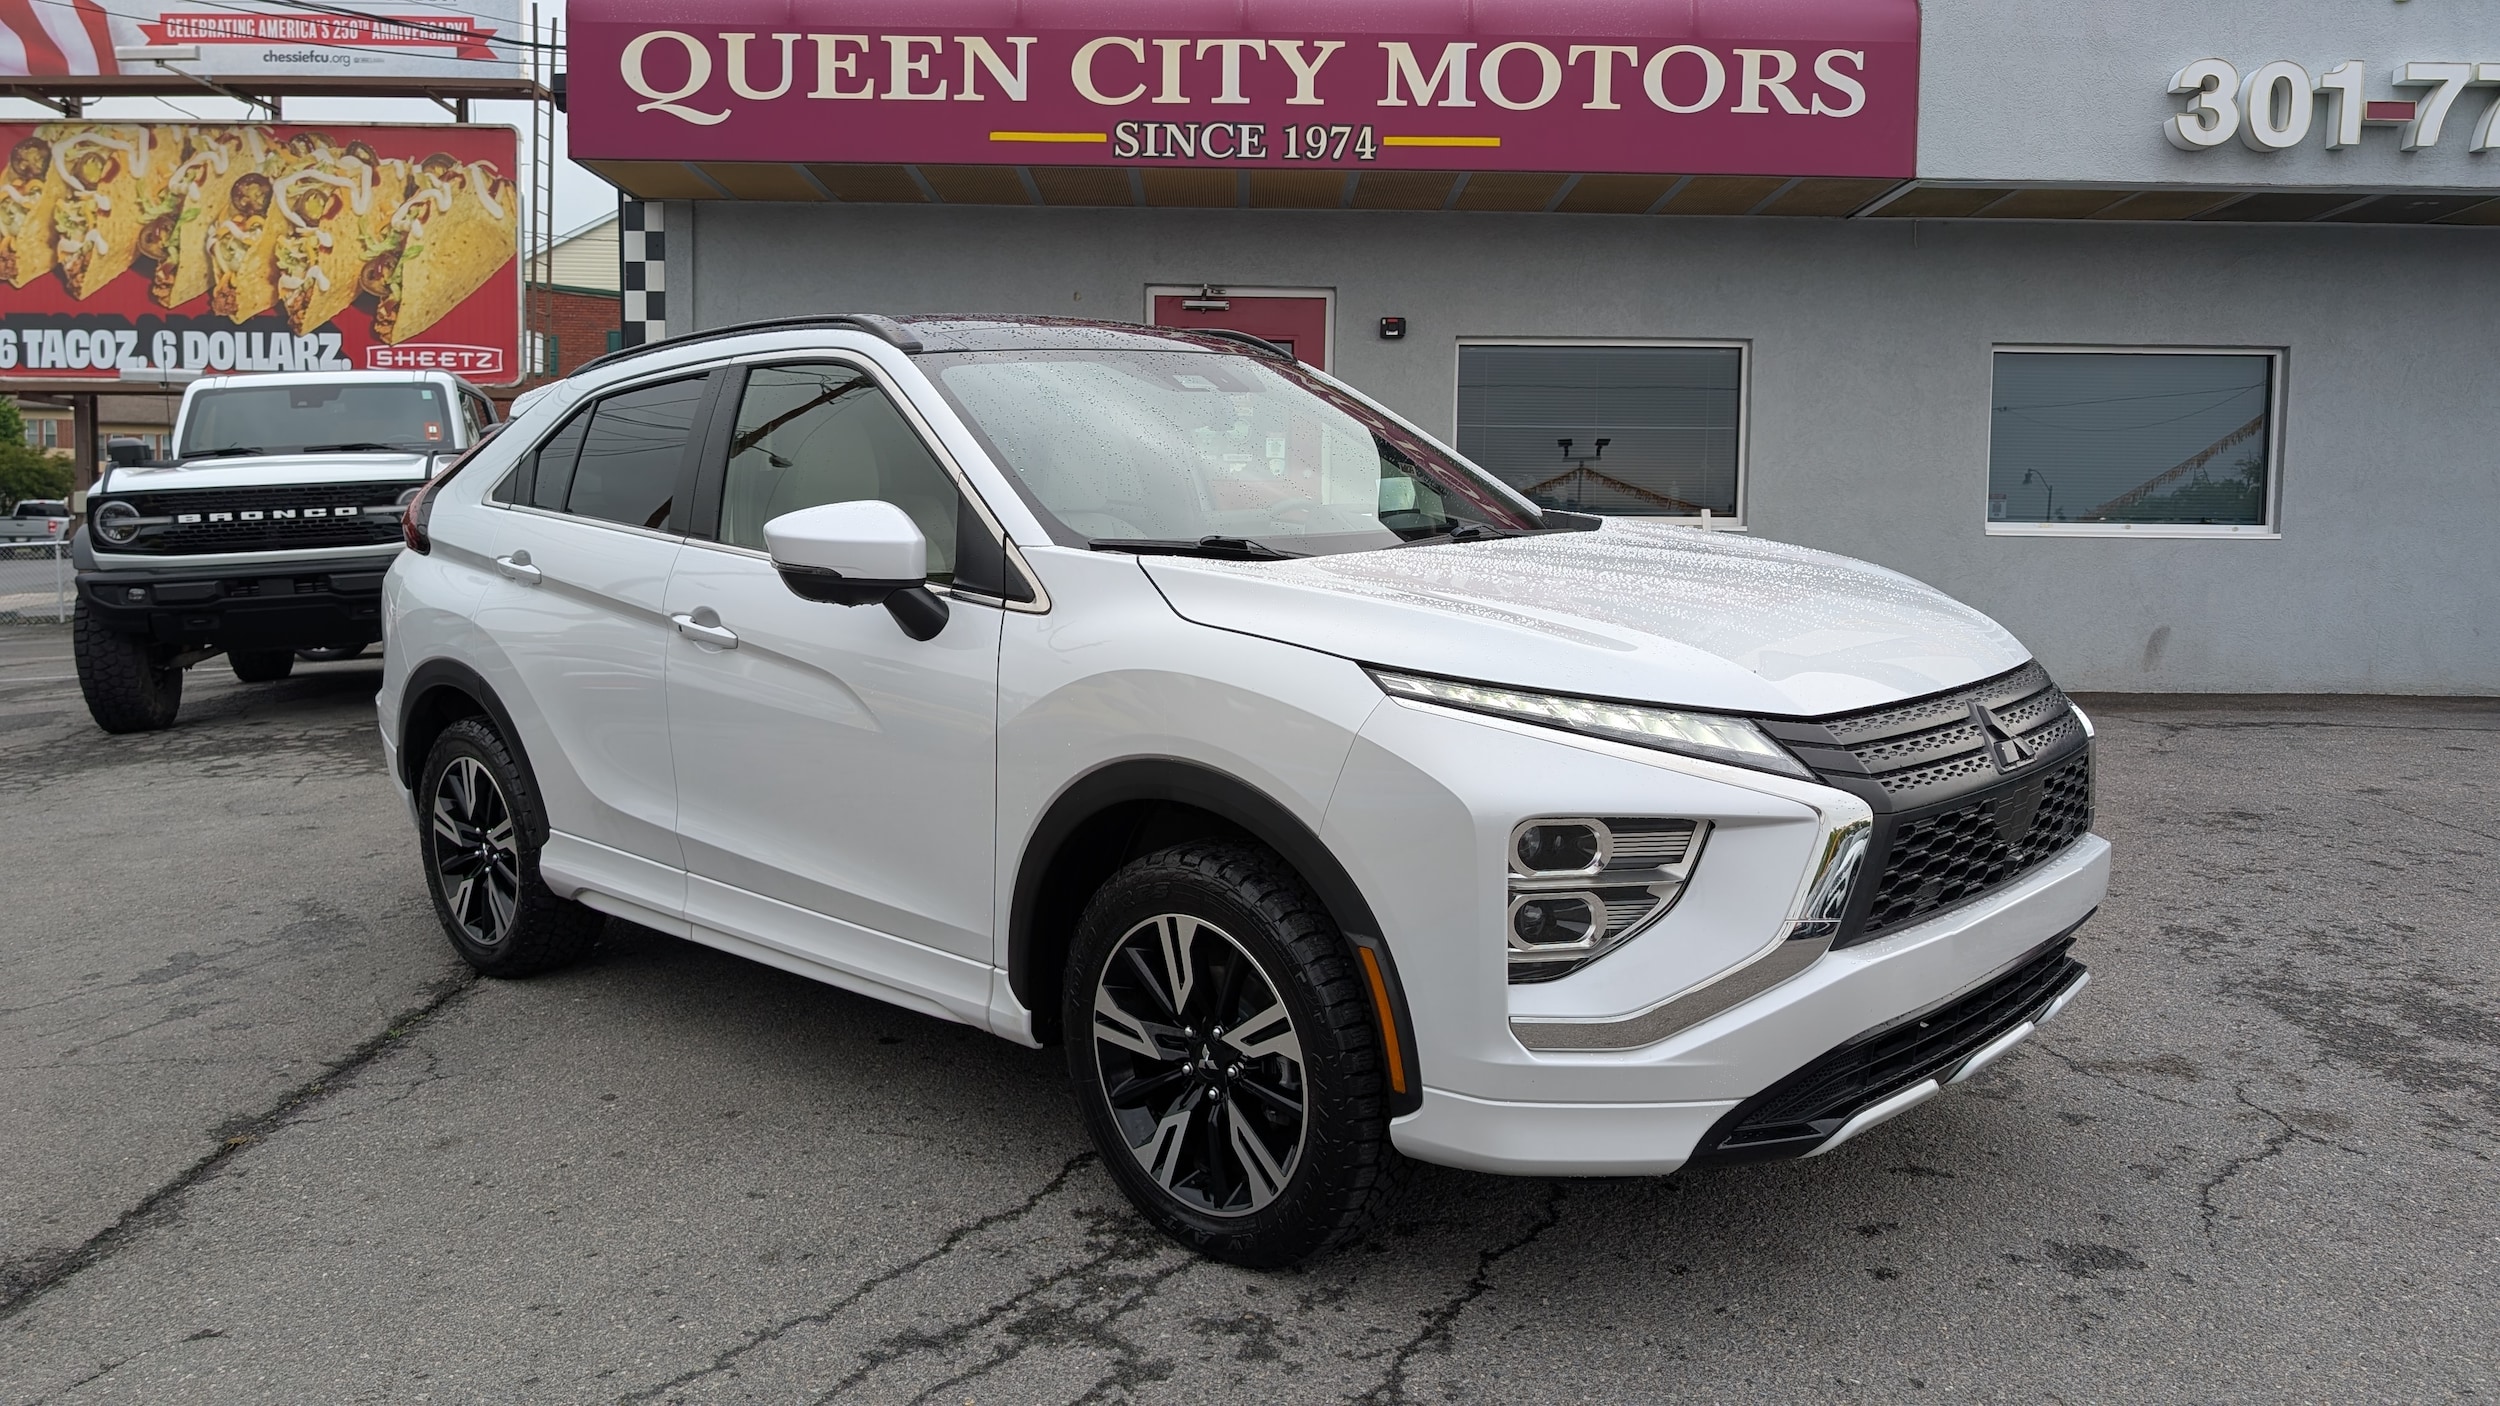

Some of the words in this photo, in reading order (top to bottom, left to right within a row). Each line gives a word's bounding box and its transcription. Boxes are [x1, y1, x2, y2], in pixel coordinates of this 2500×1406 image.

[166, 18, 256, 38] CELEBRATING
[258, 19, 331, 39] AMERICA'S
[332, 19, 370, 40] 250TH
[372, 21, 469, 42] ANNIVERSARY!
[262, 50, 351, 67] chessiefcu.org
[620, 30, 1038, 126] QUEEN
[1070, 36, 1346, 106] CITY
[1376, 41, 1867, 119] MOTORS
[1114, 121, 1268, 159] SINCE
[1283, 124, 1378, 161] 1974
[0, 328, 18, 369] 6
[22, 329, 148, 370] TACOZ.
[152, 330, 177, 370] 6
[182, 330, 352, 371] DOLLARZ.
[376, 350, 493, 368] SHEETZ
[177, 506, 358, 524] BRONCO
